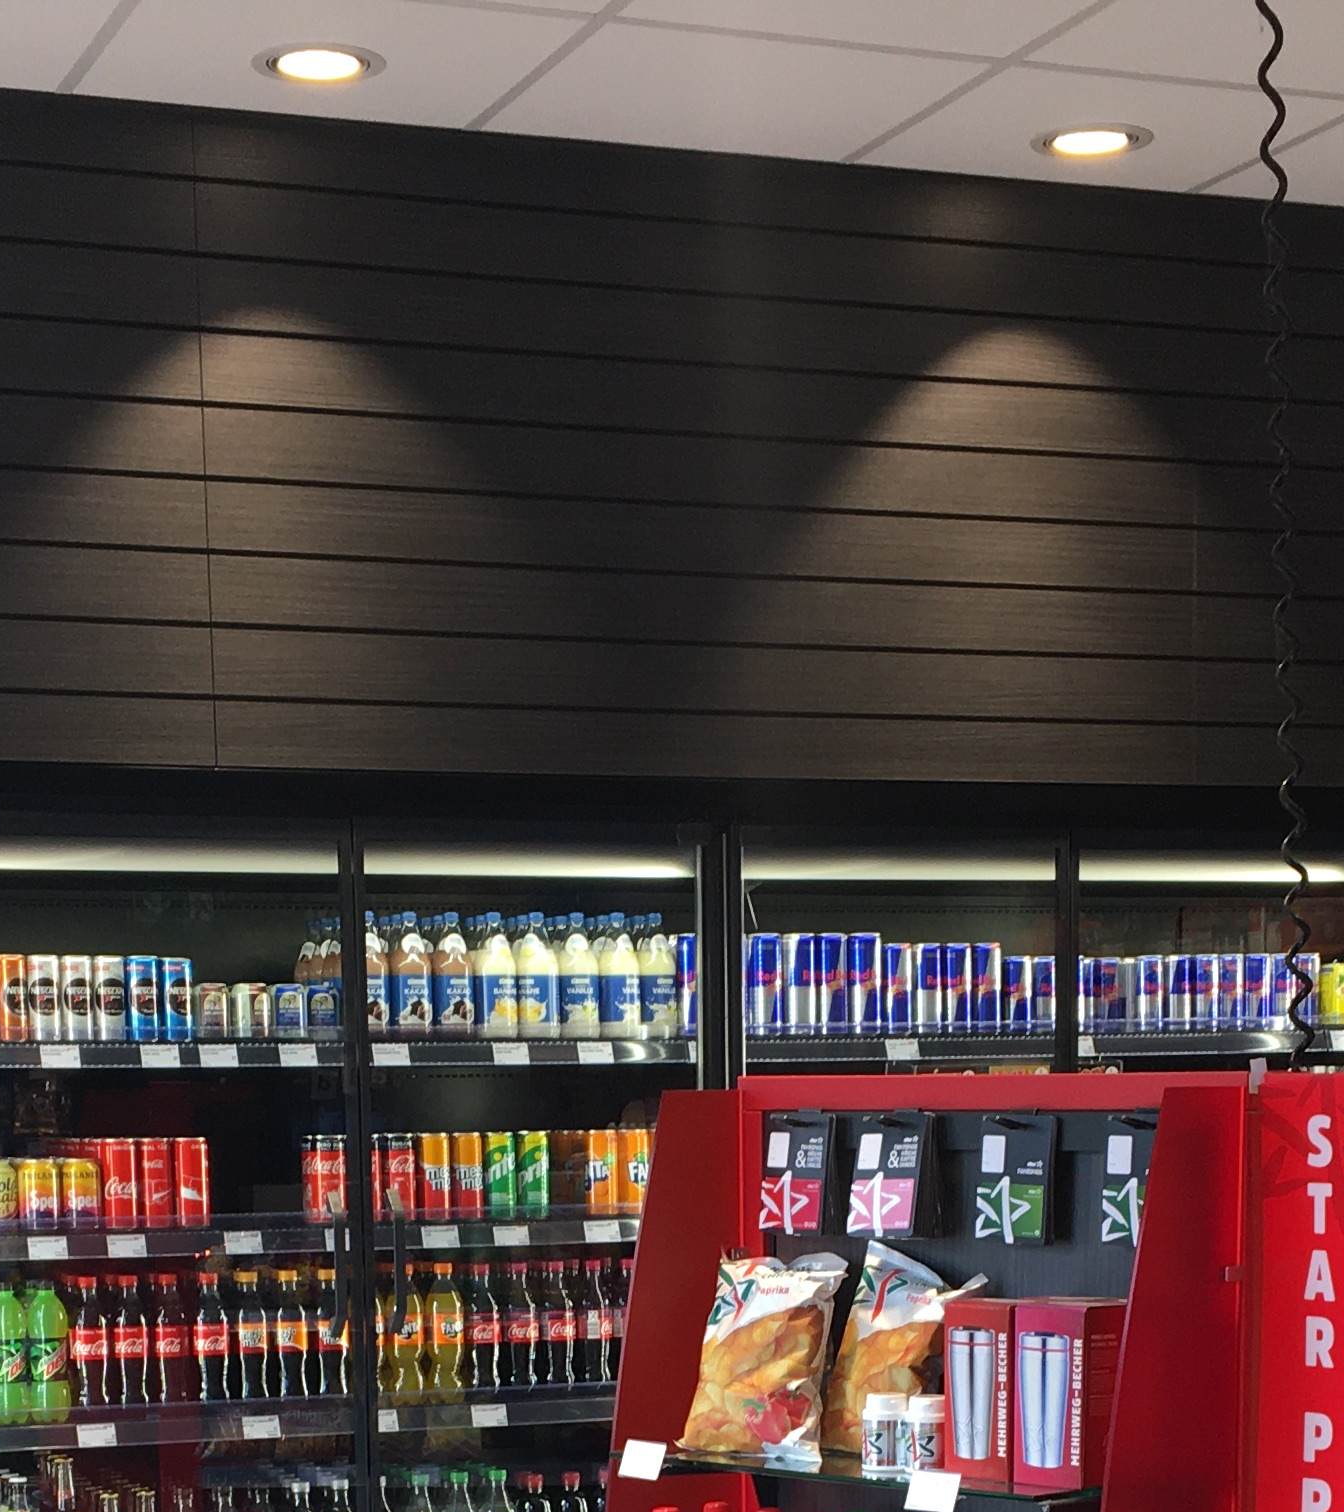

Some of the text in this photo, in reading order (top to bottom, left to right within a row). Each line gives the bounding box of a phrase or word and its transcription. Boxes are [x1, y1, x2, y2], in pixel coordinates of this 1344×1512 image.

[1303, 1114, 1335, 1370] STAR
[997, 1331, 1008, 1458] MEHRWEG-BECHER
[1070, 1338, 1083, 1467] MEHRWEG-BECHER
